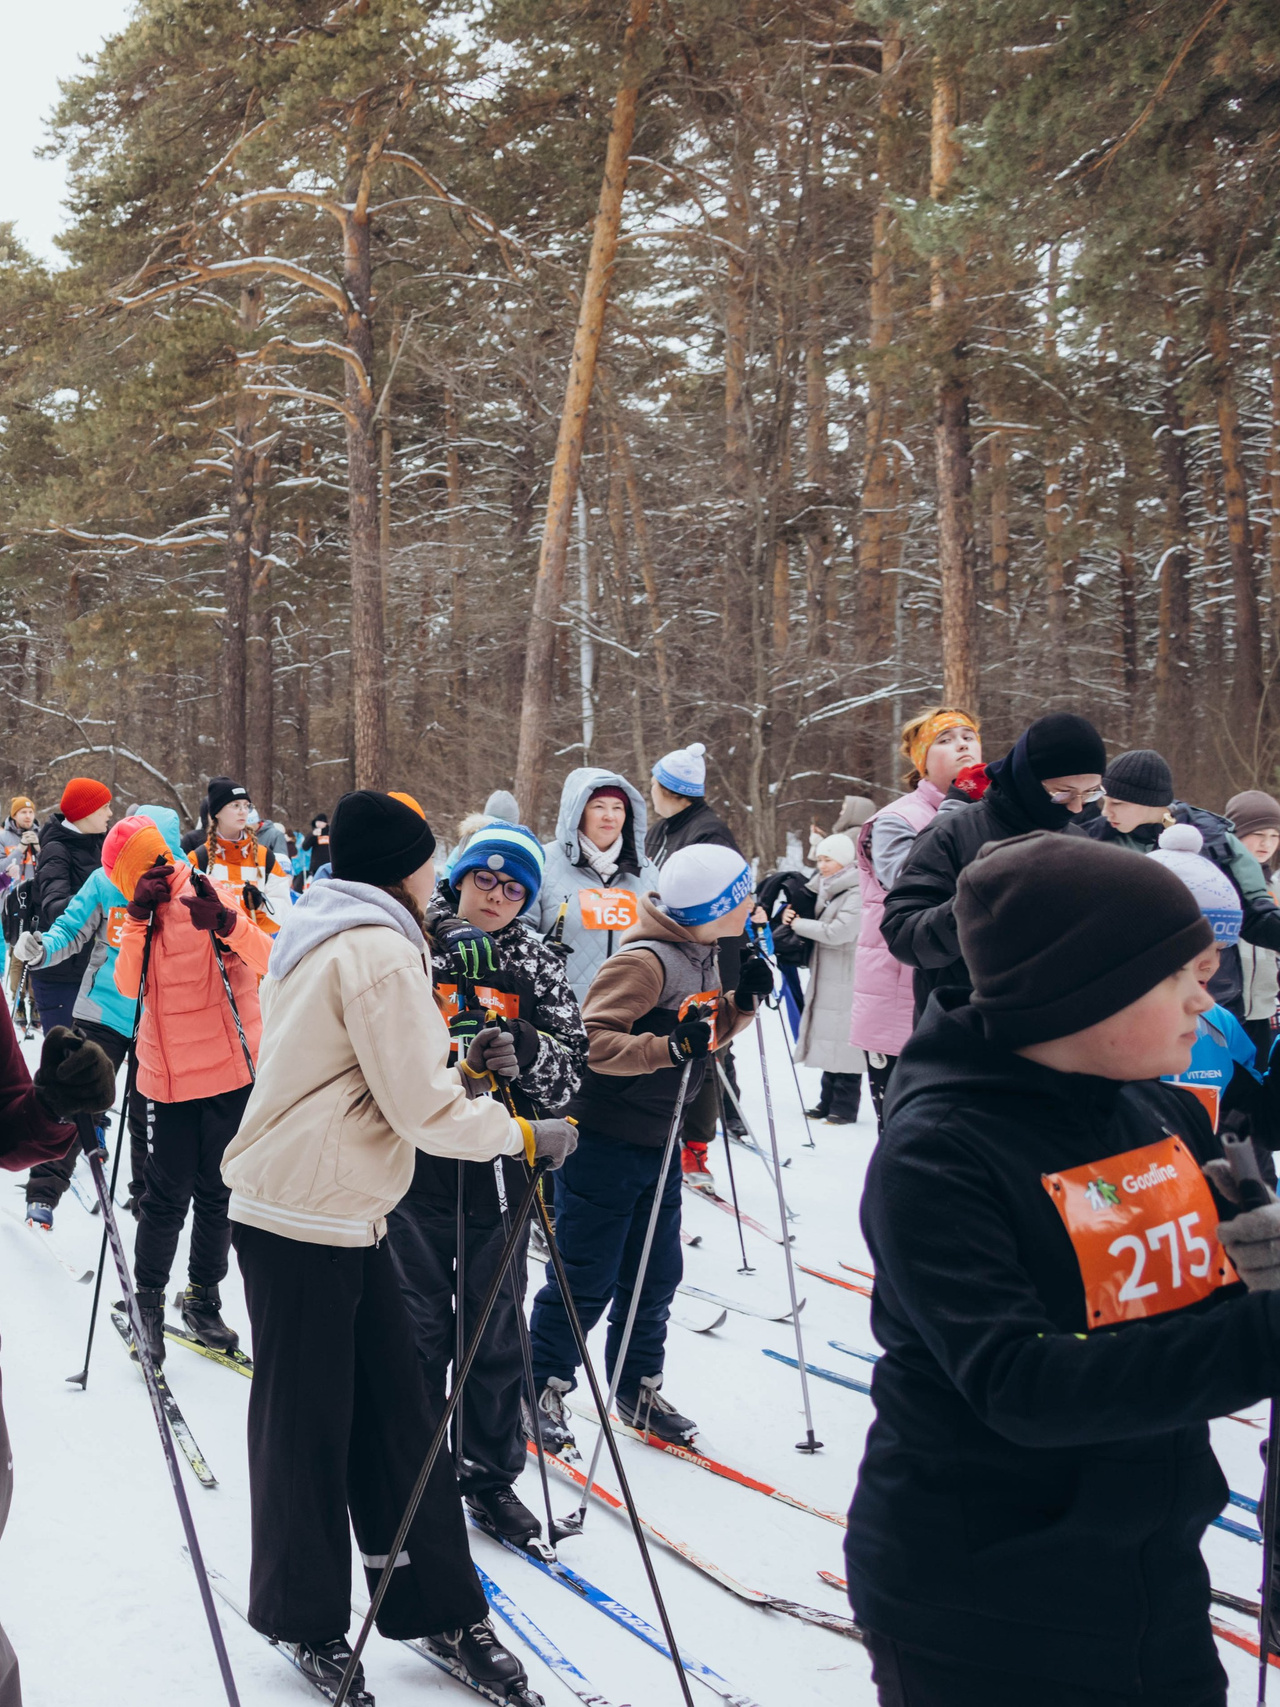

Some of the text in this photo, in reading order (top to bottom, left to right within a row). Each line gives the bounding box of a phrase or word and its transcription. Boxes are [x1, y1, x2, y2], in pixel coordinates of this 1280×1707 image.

[593, 906, 631, 926] 165
[1186, 1069, 1222, 1080] VITZHEN
[1121, 1162, 1178, 1194] Goodline
[1107, 1211, 1212, 1303] 275
[204, 1350, 240, 1371] FISCHER
[663, 1445, 712, 1470] ATOMIC
